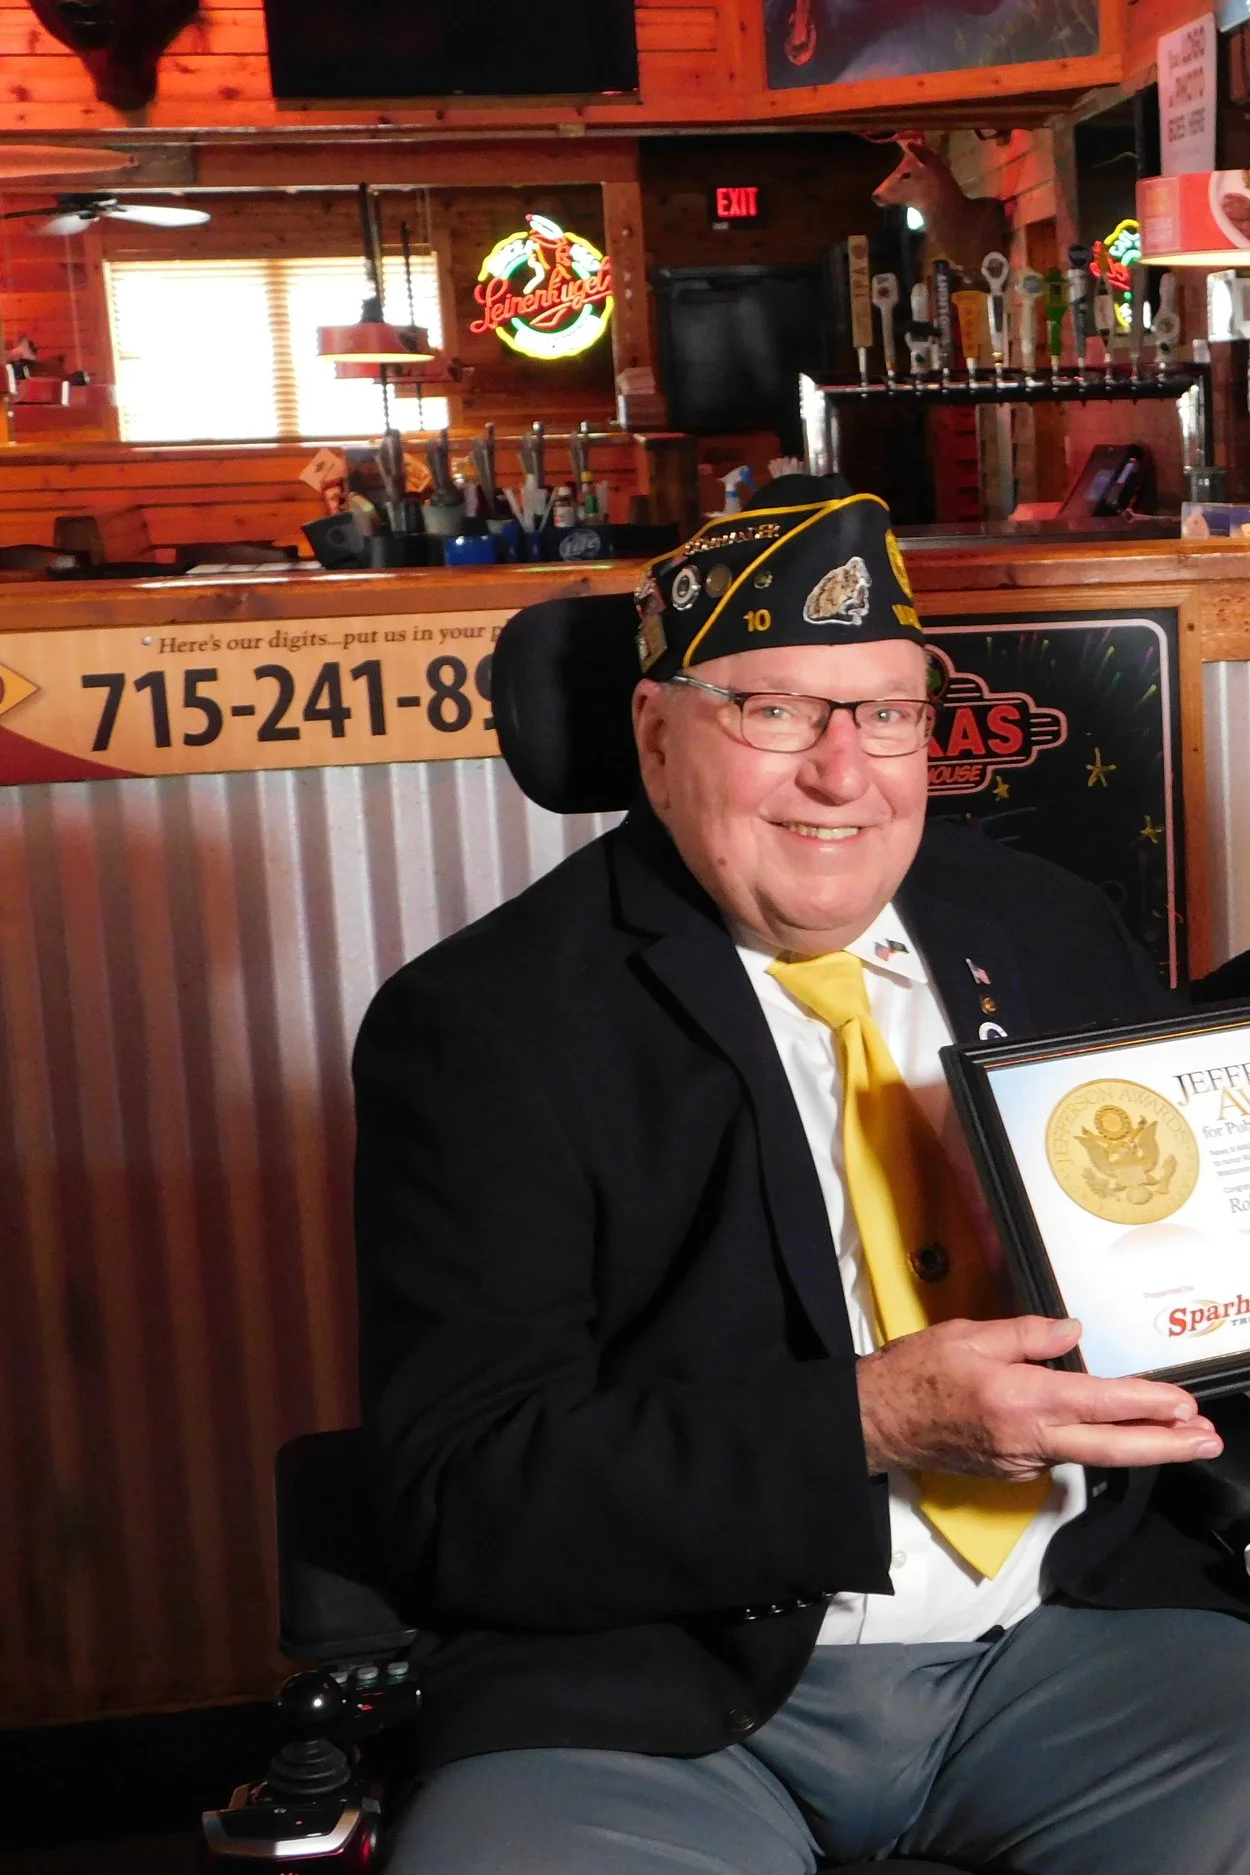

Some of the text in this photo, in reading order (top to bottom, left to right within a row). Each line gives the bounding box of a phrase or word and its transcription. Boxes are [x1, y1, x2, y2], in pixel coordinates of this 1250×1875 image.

[717, 187, 758, 218] EXIT
[744, 609, 771, 632] 10
[158, 633, 222, 655] Here's
[226, 636, 263, 652] our
[384, 630, 407, 644] us
[413, 625, 434, 643] in
[438, 626, 486, 646] your
[1202, 1125, 1223, 1139] for
